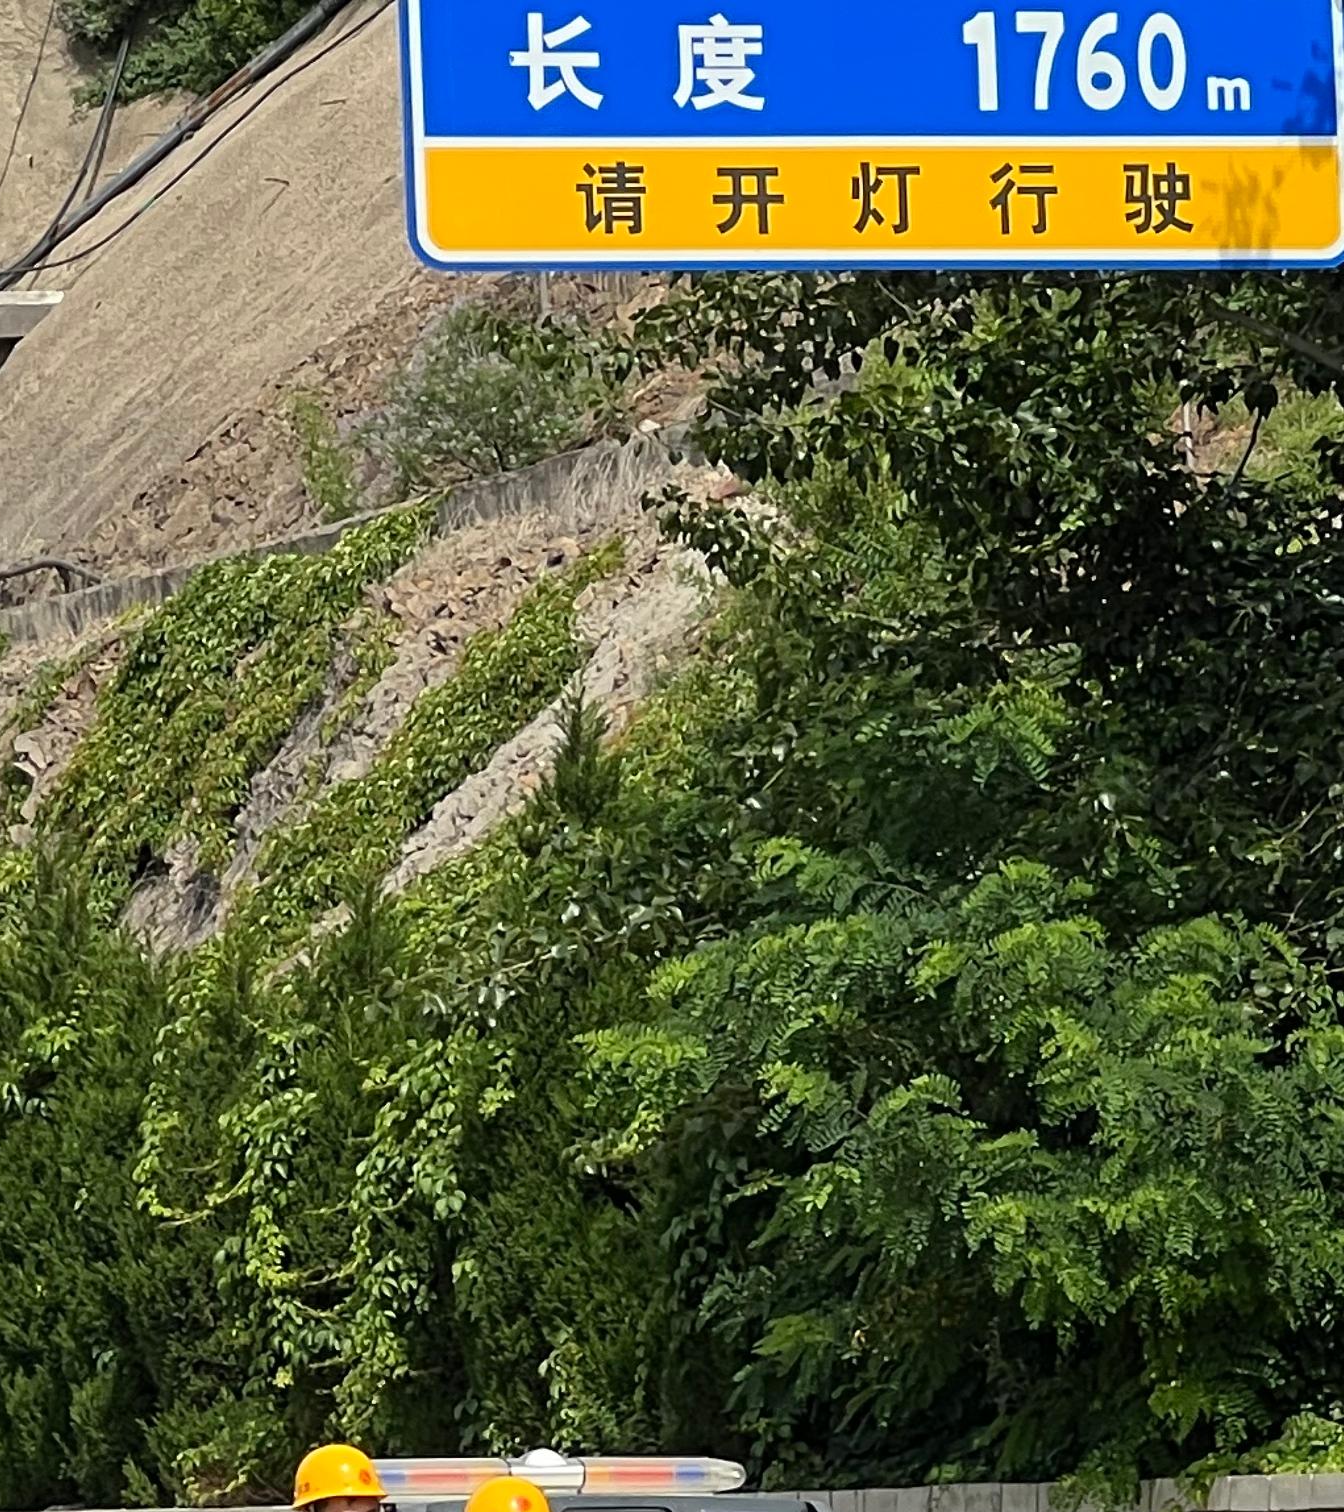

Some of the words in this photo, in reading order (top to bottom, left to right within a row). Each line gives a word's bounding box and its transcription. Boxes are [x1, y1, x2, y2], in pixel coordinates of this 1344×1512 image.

[575, 162, 1194, 235] 请开灯行驶
